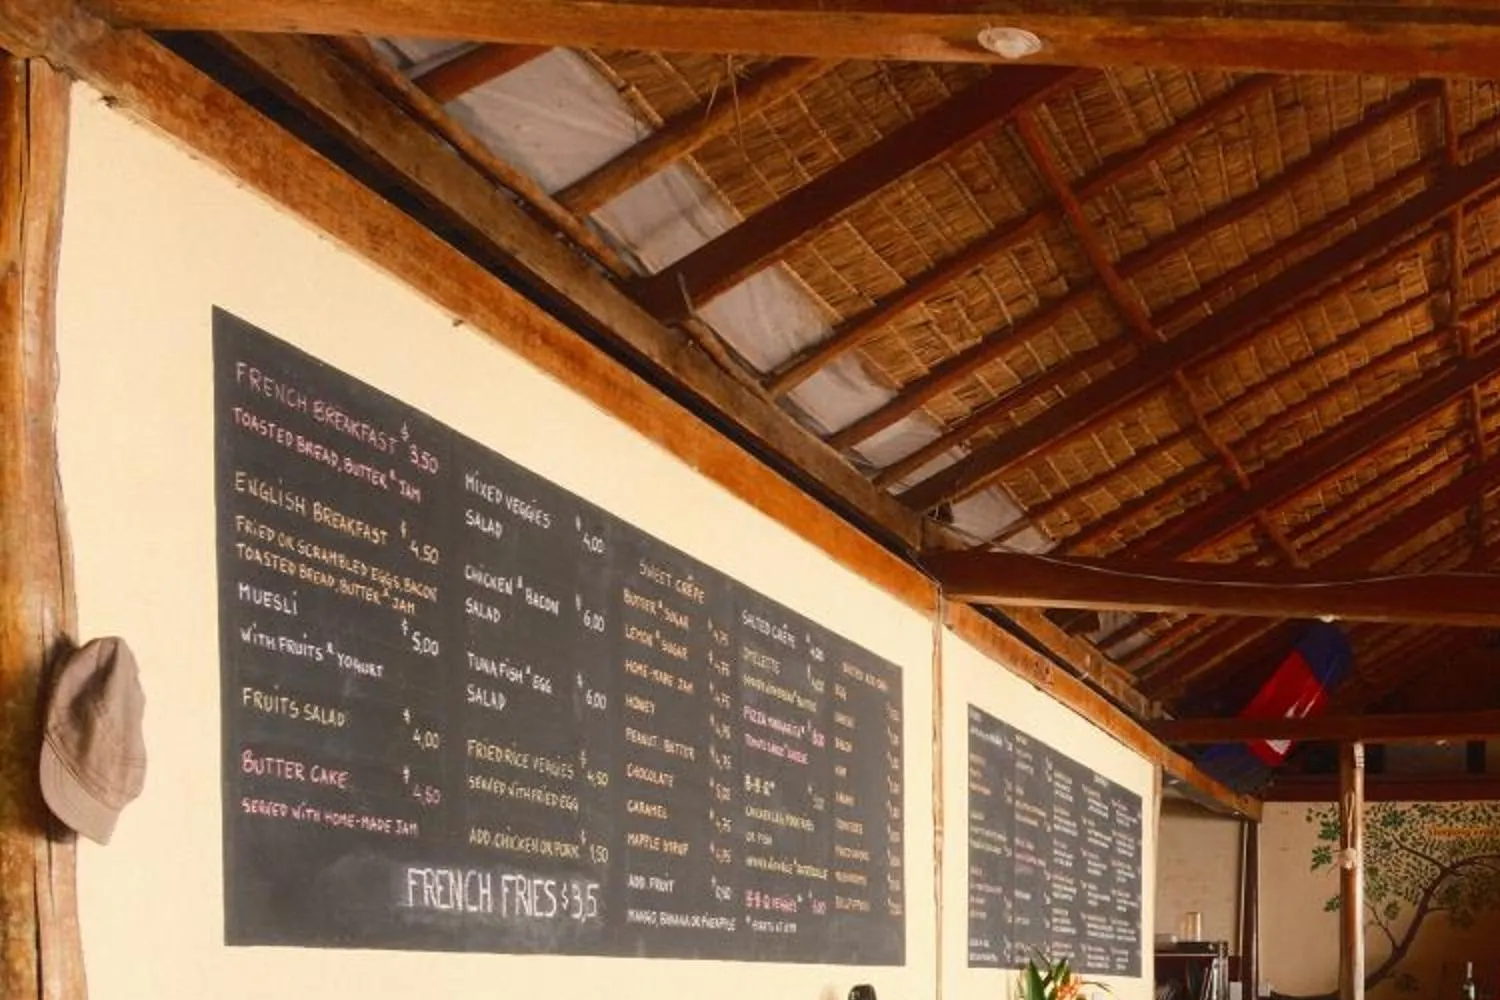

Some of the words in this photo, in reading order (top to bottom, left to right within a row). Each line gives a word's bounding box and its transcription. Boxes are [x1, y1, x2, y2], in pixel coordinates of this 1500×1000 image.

[236, 361, 307, 412] FRENCH
[313, 400, 399, 454] BREAKFAST
[232, 407, 293, 447] TOASTED
[344, 458, 388, 490] BUTTER
[399, 479, 421, 503] JAM
[465, 470, 502, 504] MIXED
[313, 501, 388, 545] BREAKFAST
[465, 509, 503, 540] SALAD
[236, 543, 296, 575] TOASTED
[340, 579, 381, 605] BUTTER
[392, 598, 415, 615] JAM
[298, 540, 368, 576] SCRAMBLED
[403, 578, 437, 602] BACON
[464, 564, 513, 596] CHICKEN
[525, 587, 560, 616] BACON
[465, 597, 501, 623] SALAD
[467, 651, 498, 678] TUNA
[532, 674, 552, 694] EGG
[304, 703, 345, 727] SALAD
[467, 684, 507, 711] SALAD
[241, 749, 305, 781] BUTTER
[310, 765, 350, 789] CAKE
[467, 739, 502, 762] FRIED
[469, 775, 505, 796] SERVED
[241, 797, 288, 818] SERVED
[324, 812, 391, 834] HOME-MADE
[395, 819, 419, 837] JAM
[408, 868, 492, 913] FRENCH
[501, 874, 556, 918] FRIES
